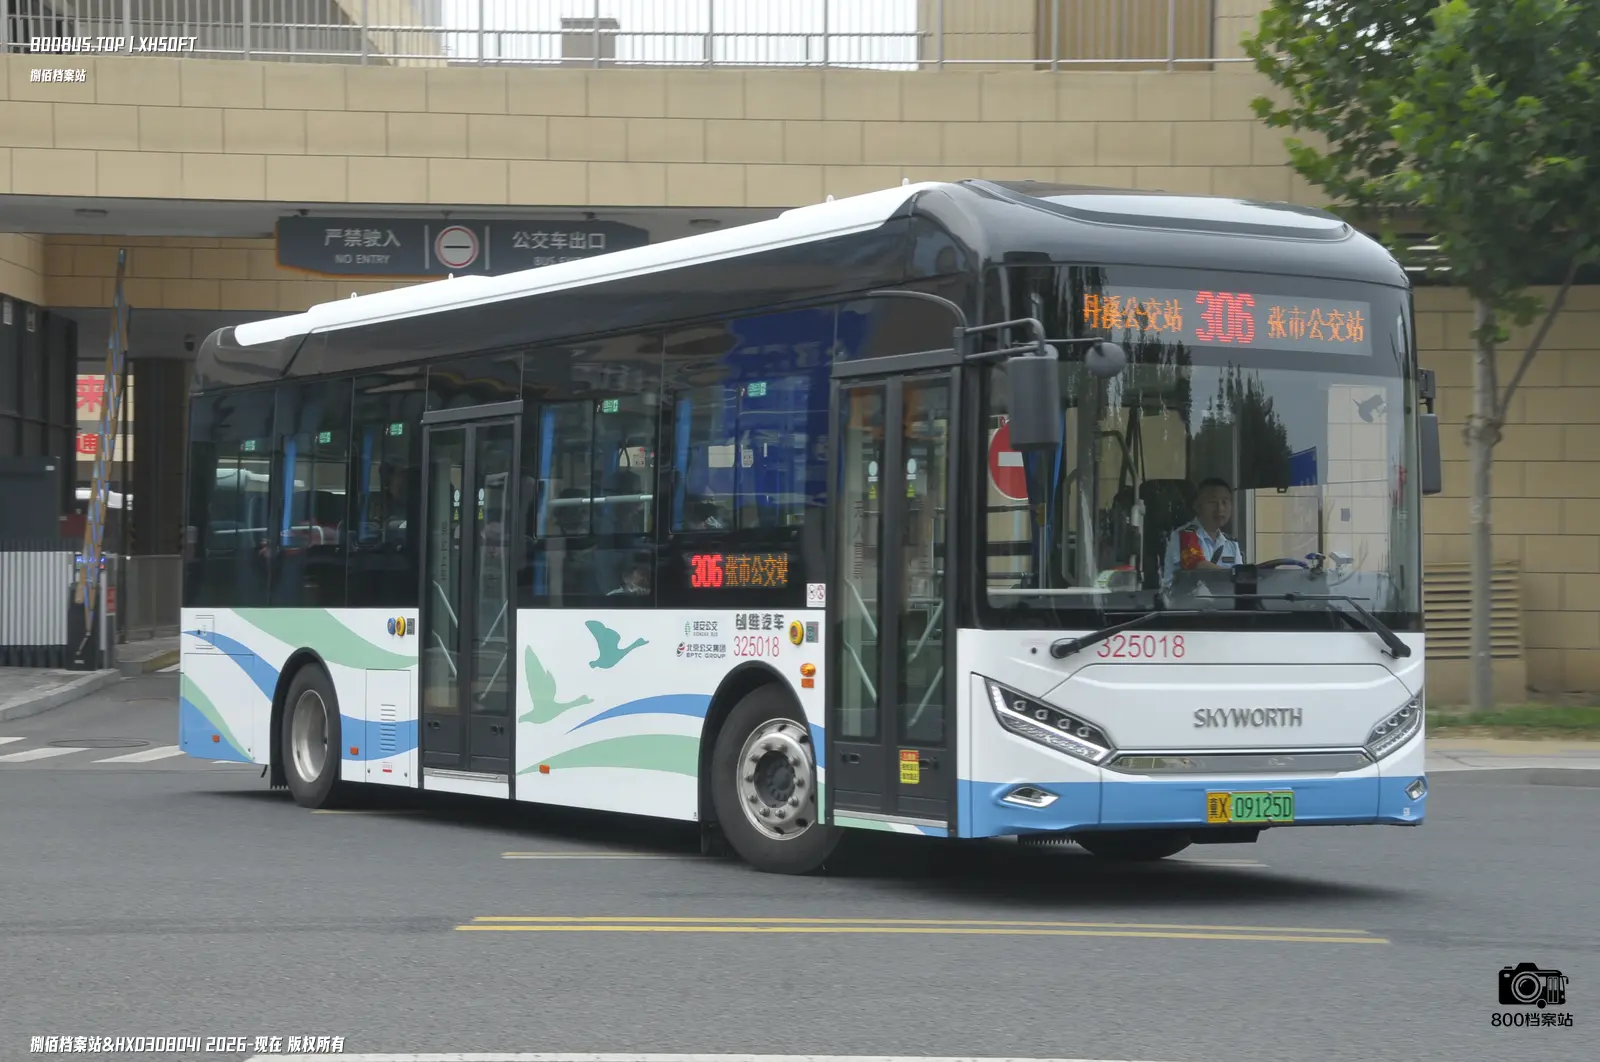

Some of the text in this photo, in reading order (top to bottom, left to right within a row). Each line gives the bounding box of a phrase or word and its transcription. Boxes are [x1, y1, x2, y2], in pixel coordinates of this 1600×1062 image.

[324, 228, 401, 248] 严禁驶入
[512, 231, 606, 250] 公交车出口
[335, 254, 390, 265] NO ENTRY
[1195, 291, 1256, 344] 306
[1267, 305, 1365, 343] 张市公交站
[691, 554, 723, 588] 306
[736, 613, 784, 631] 创维汽车
[686, 644, 727, 653] 北京公交集团
[733, 635, 780, 657] 325018
[1097, 634, 1185, 658] 325018
[1193, 706, 1303, 729] SKYWORTH
